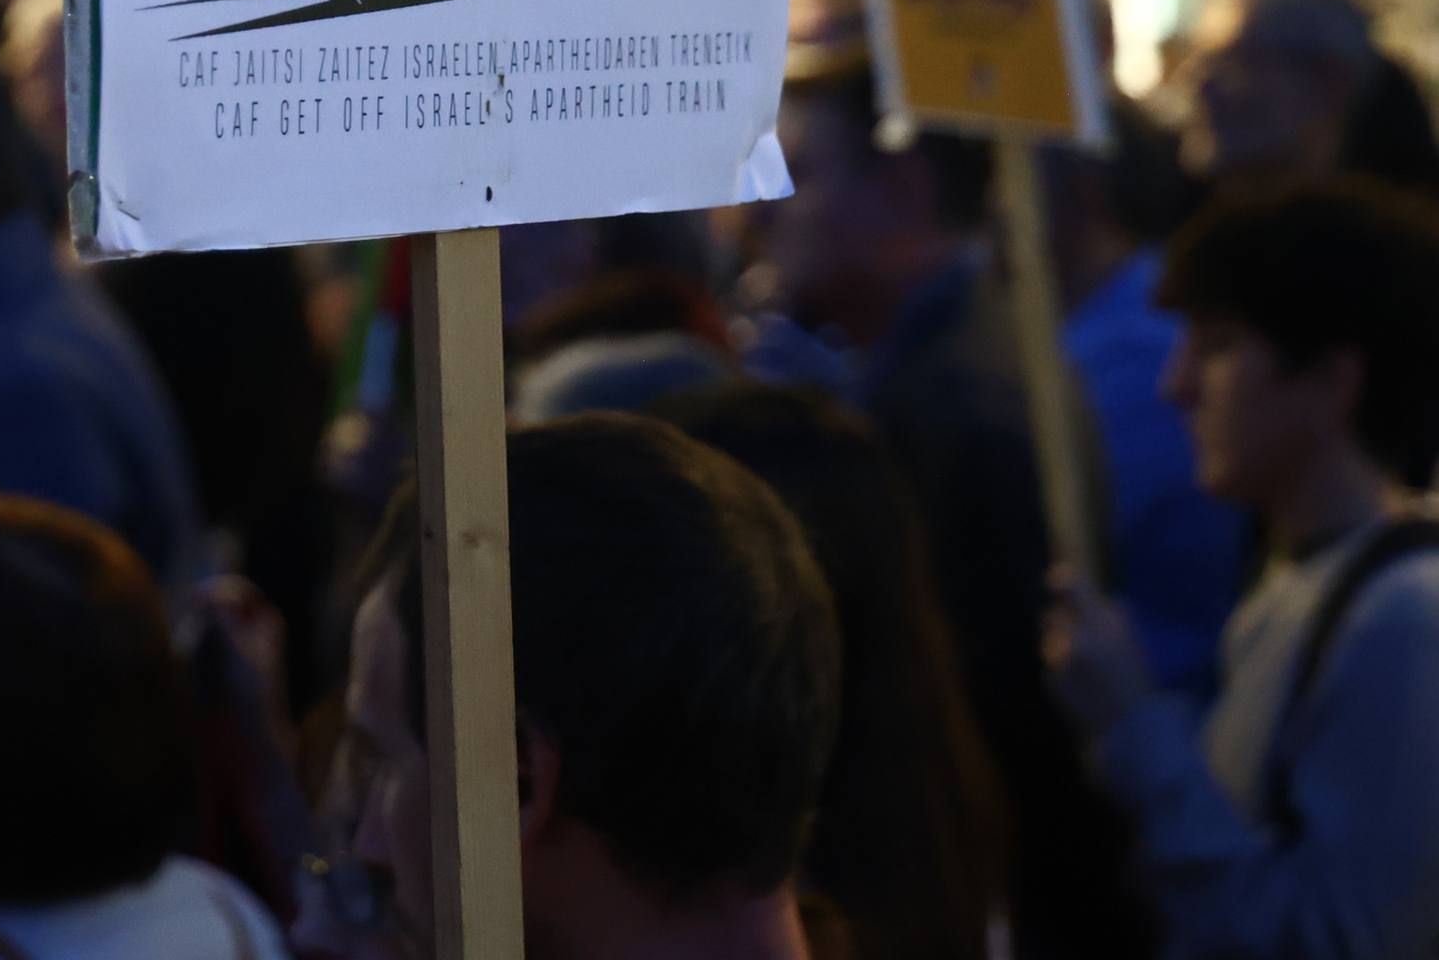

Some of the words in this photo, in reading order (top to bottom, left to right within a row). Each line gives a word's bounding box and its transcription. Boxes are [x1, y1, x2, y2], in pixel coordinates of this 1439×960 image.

[179, 51, 218, 86] CAF
[232, 50, 303, 84] JAITSI
[317, 46, 388, 81] ZAITEZ
[403, 43, 498, 78] ISRAELEN
[509, 36, 659, 71] APARTHEIDAREN
[670, 33, 751, 65] TRENETIK
[215, 102, 258, 138] CAF
[279, 99, 321, 135] GET
[343, 97, 383, 131] OFF
[529, 83, 649, 120] APARTHEID
[665, 80, 726, 113] TRAIN
